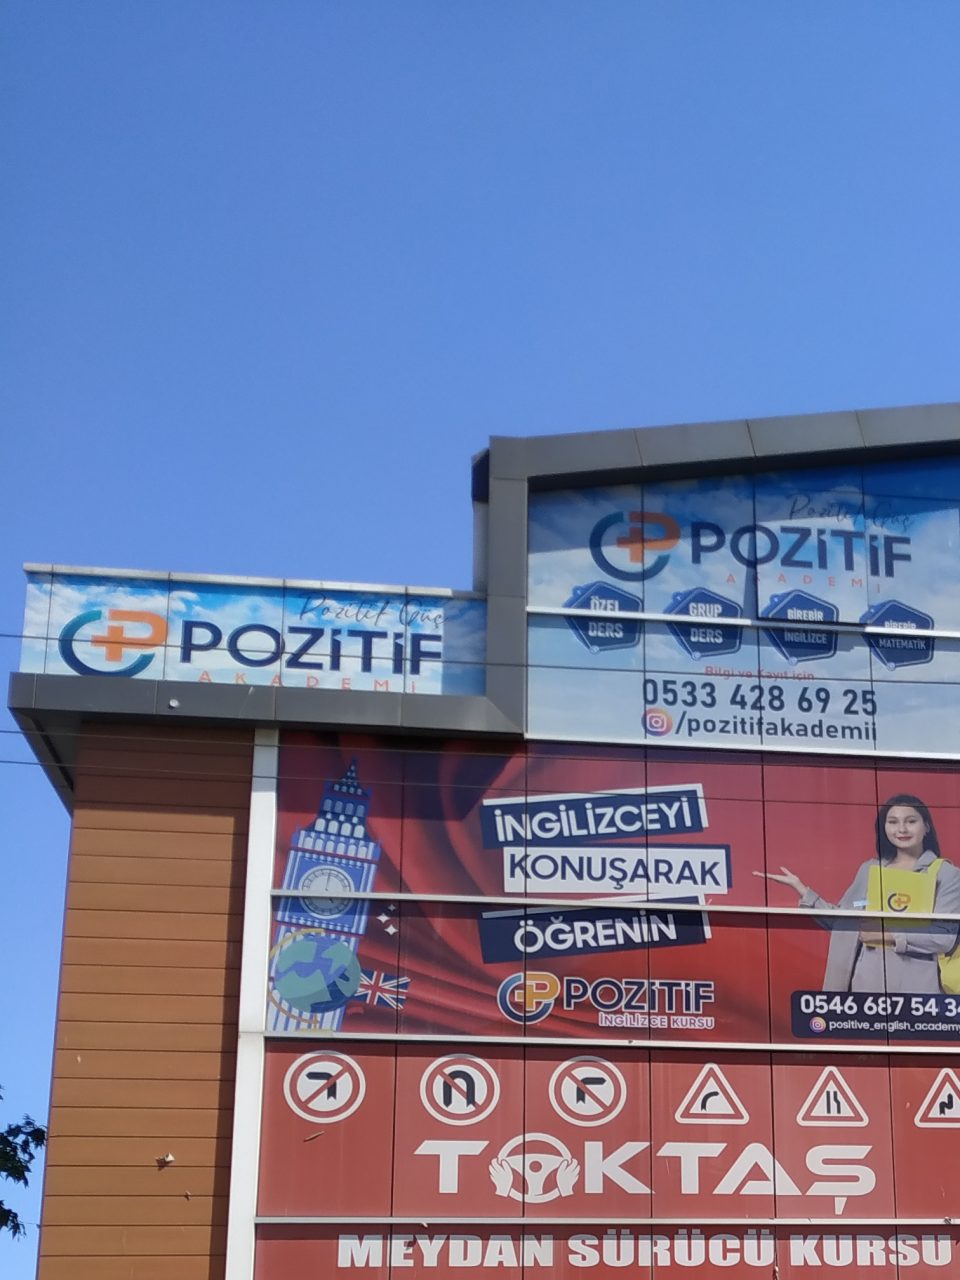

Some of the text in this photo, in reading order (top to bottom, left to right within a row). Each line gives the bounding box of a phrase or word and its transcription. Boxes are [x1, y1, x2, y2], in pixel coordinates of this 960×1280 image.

[689, 602, 723, 618] GRUP
[787, 607, 825, 622] BİREBİR
[588, 621, 624, 639] DERS
[690, 627, 723, 645] DERS
[784, 629, 828, 646] İNGİLİZCE
[879, 637, 927, 651] MATEMATİK
[704, 665, 735, 680] Bilgi
[737, 669, 753, 679] ve
[757, 668, 788, 682] Kayıt
[644, 678, 878, 717] 0533 428 69 25
[494, 797, 691, 843] İNGİLİZCEYİ
[508, 853, 720, 890] KONUŞARAK
[514, 910, 678, 954] ÖĞRENİN
[800, 994, 858, 1016] 0546
[863, 996, 904, 1017] 687
[910, 998, 939, 1017] 54
[599, 1011, 715, 1030] İNGİLİZCE KURSU
[337, 1228, 953, 1268] MEYDAN SÜRÜCÜ KURSU
